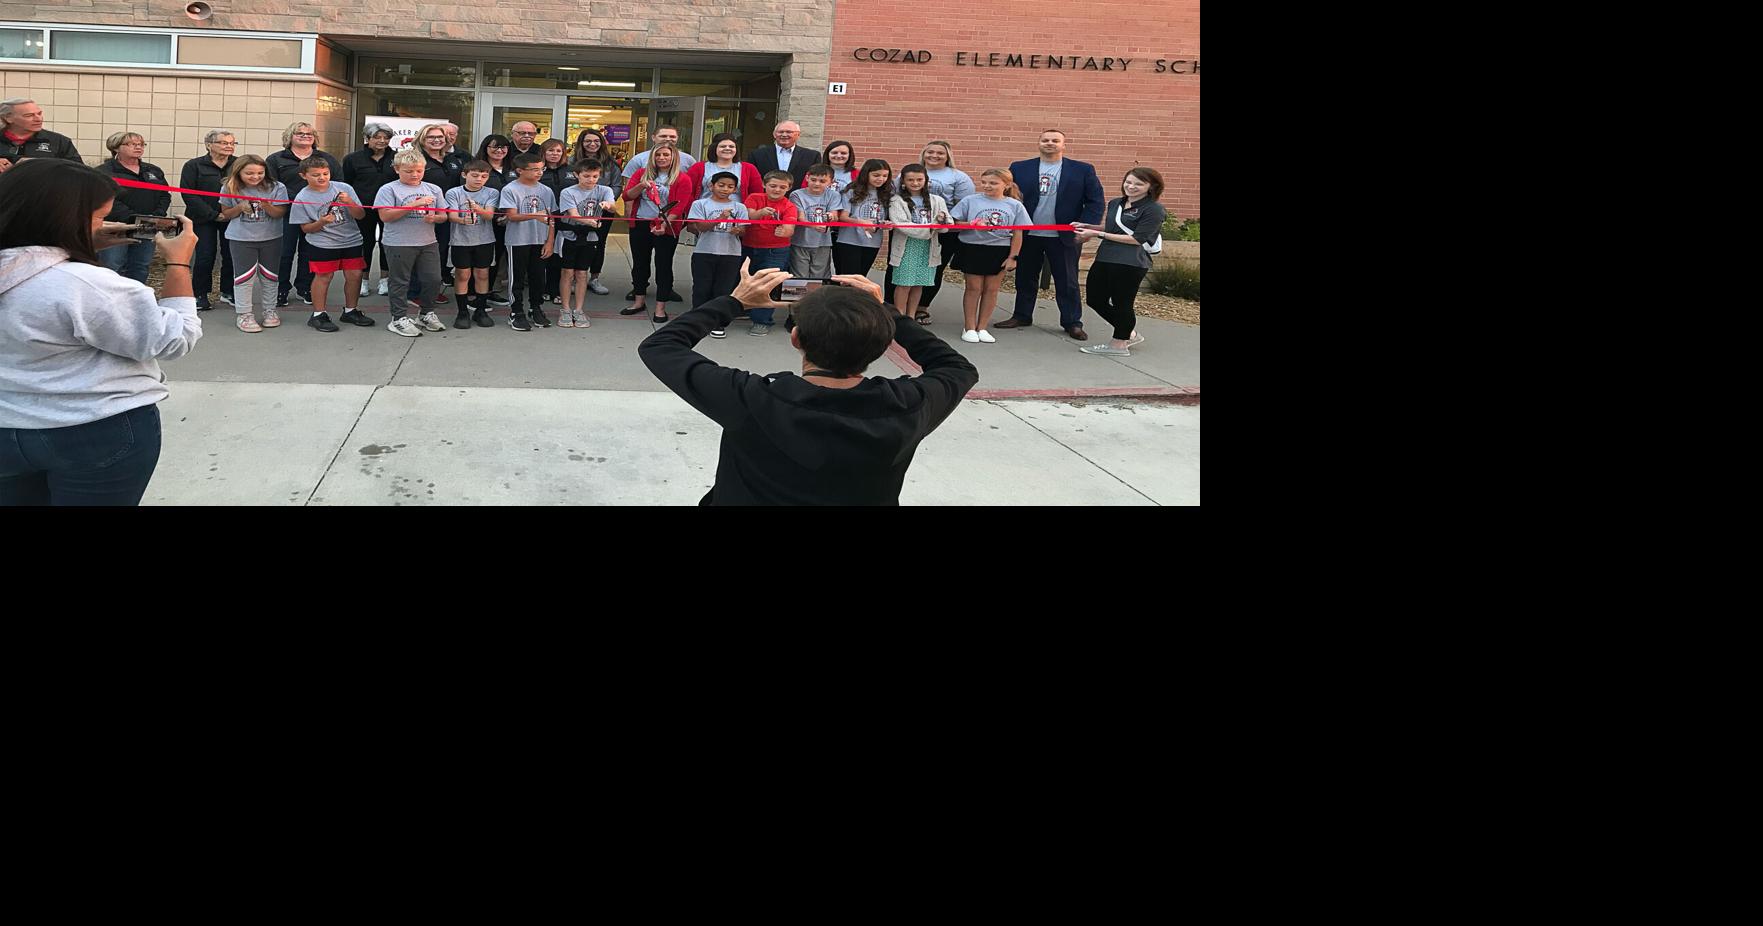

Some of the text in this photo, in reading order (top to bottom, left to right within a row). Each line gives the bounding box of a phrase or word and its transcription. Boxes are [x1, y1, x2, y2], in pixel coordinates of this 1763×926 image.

[853, 47, 932, 64] COZAD
[955, 51, 1132, 72] ELEMENTARY
[832, 84, 843, 93] E1
